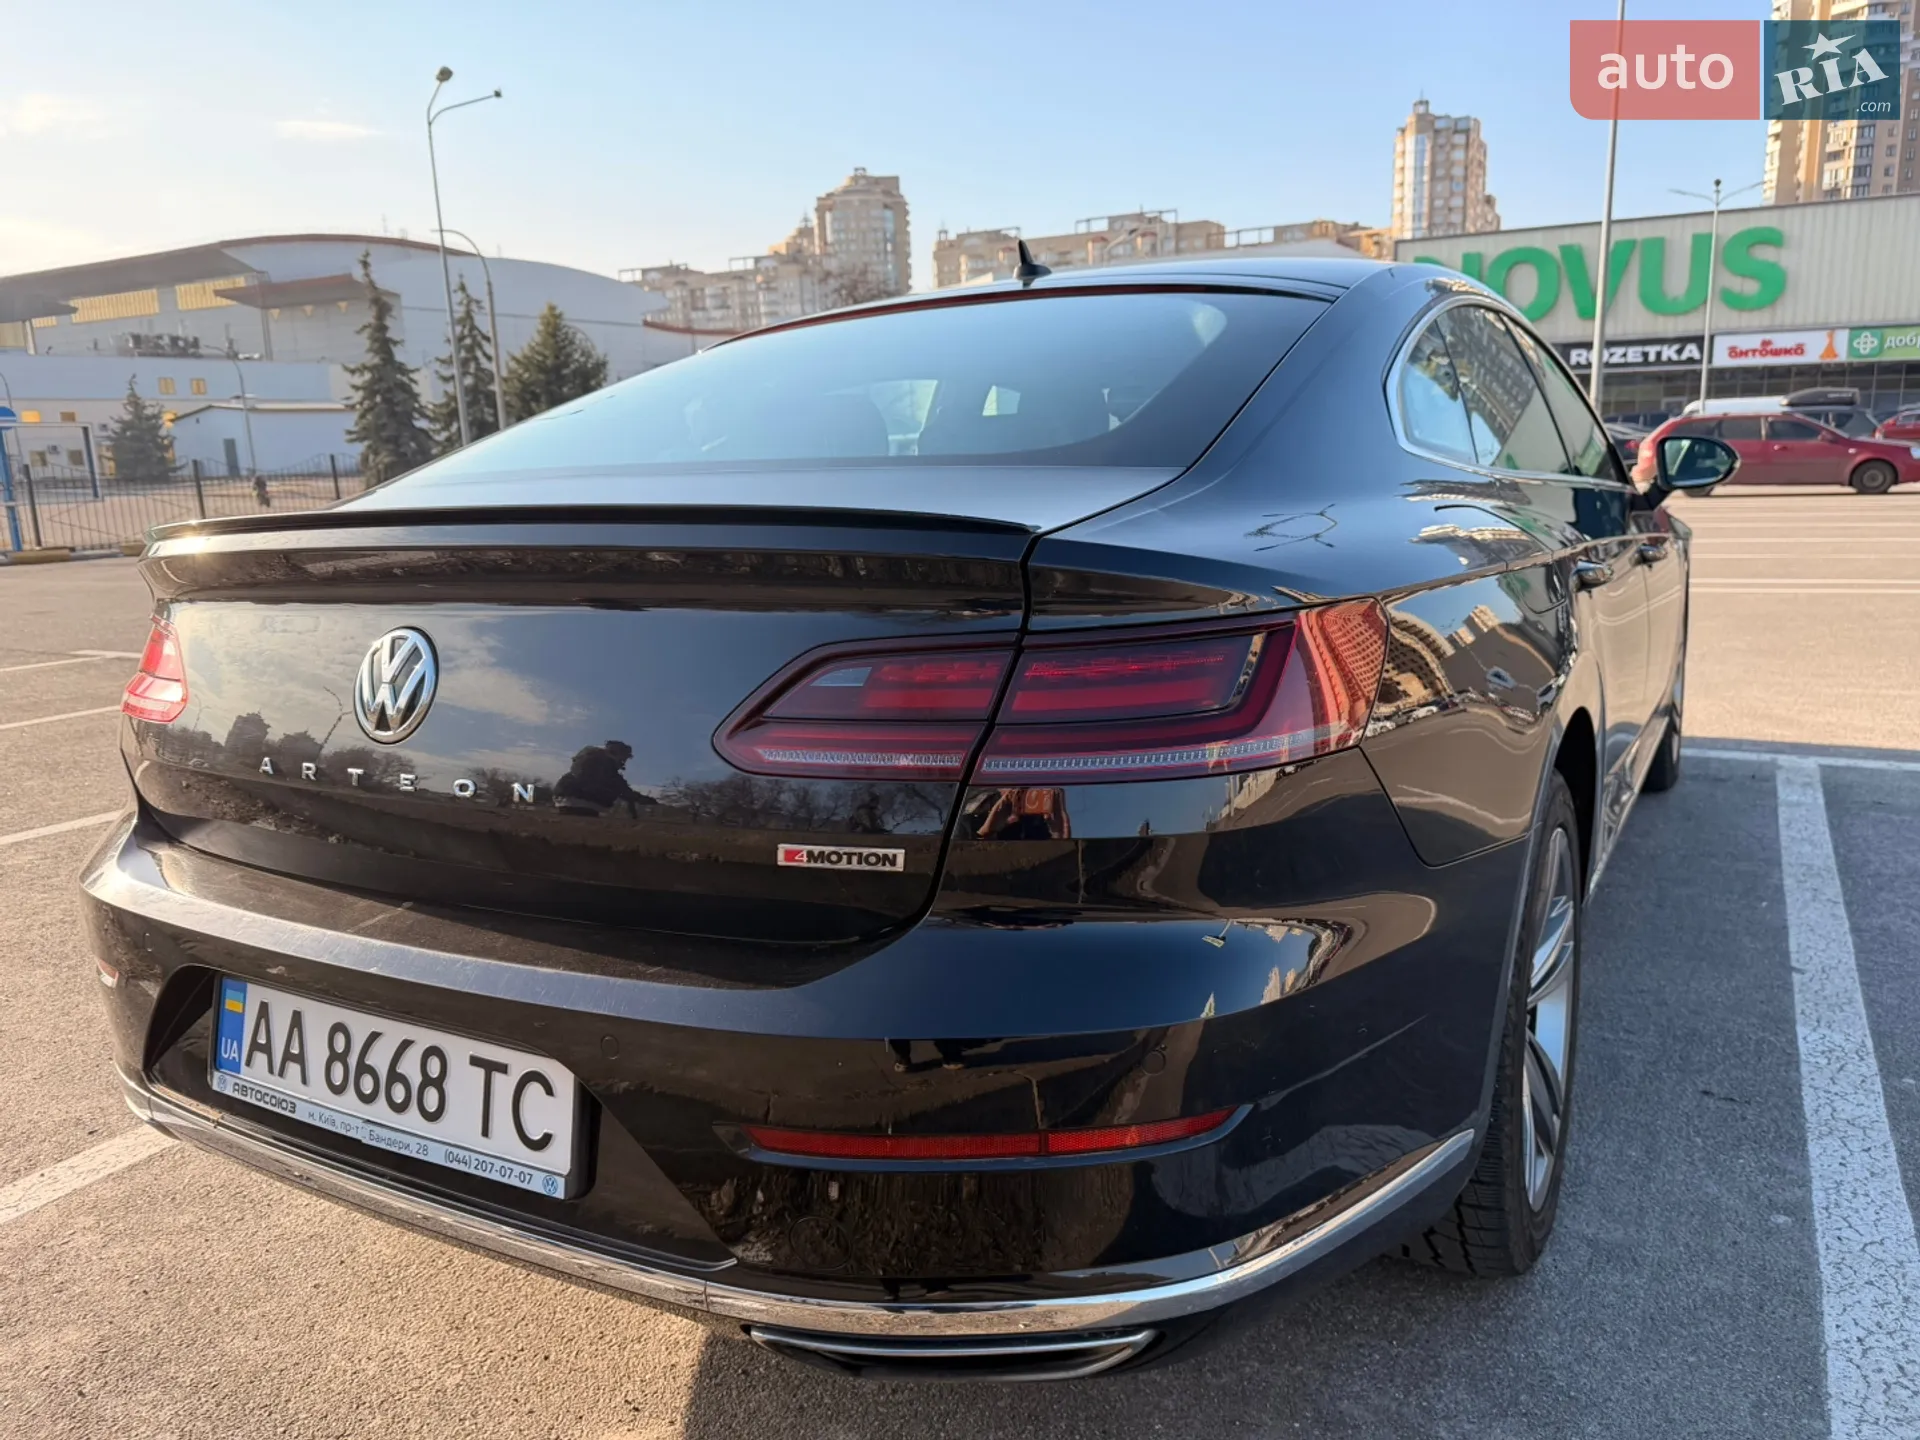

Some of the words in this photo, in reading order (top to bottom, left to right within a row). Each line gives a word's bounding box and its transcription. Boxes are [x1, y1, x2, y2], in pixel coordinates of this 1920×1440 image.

[1884, 332, 1920, 349] доб
[258, 757, 535, 803] ARTEON
[794, 849, 898, 867] 4MOTION
[221, 1037, 239, 1063] UA
[245, 1000, 308, 1086] AA
[324, 1021, 448, 1123] 8668
[469, 1053, 555, 1152] TC
[232, 1082, 297, 1115] АВТОСОЮЗ
[415, 1142, 429, 1156] 28
[443, 1148, 472, 1168] (044)
[473, 1158, 534, 1185] 207-07-07
